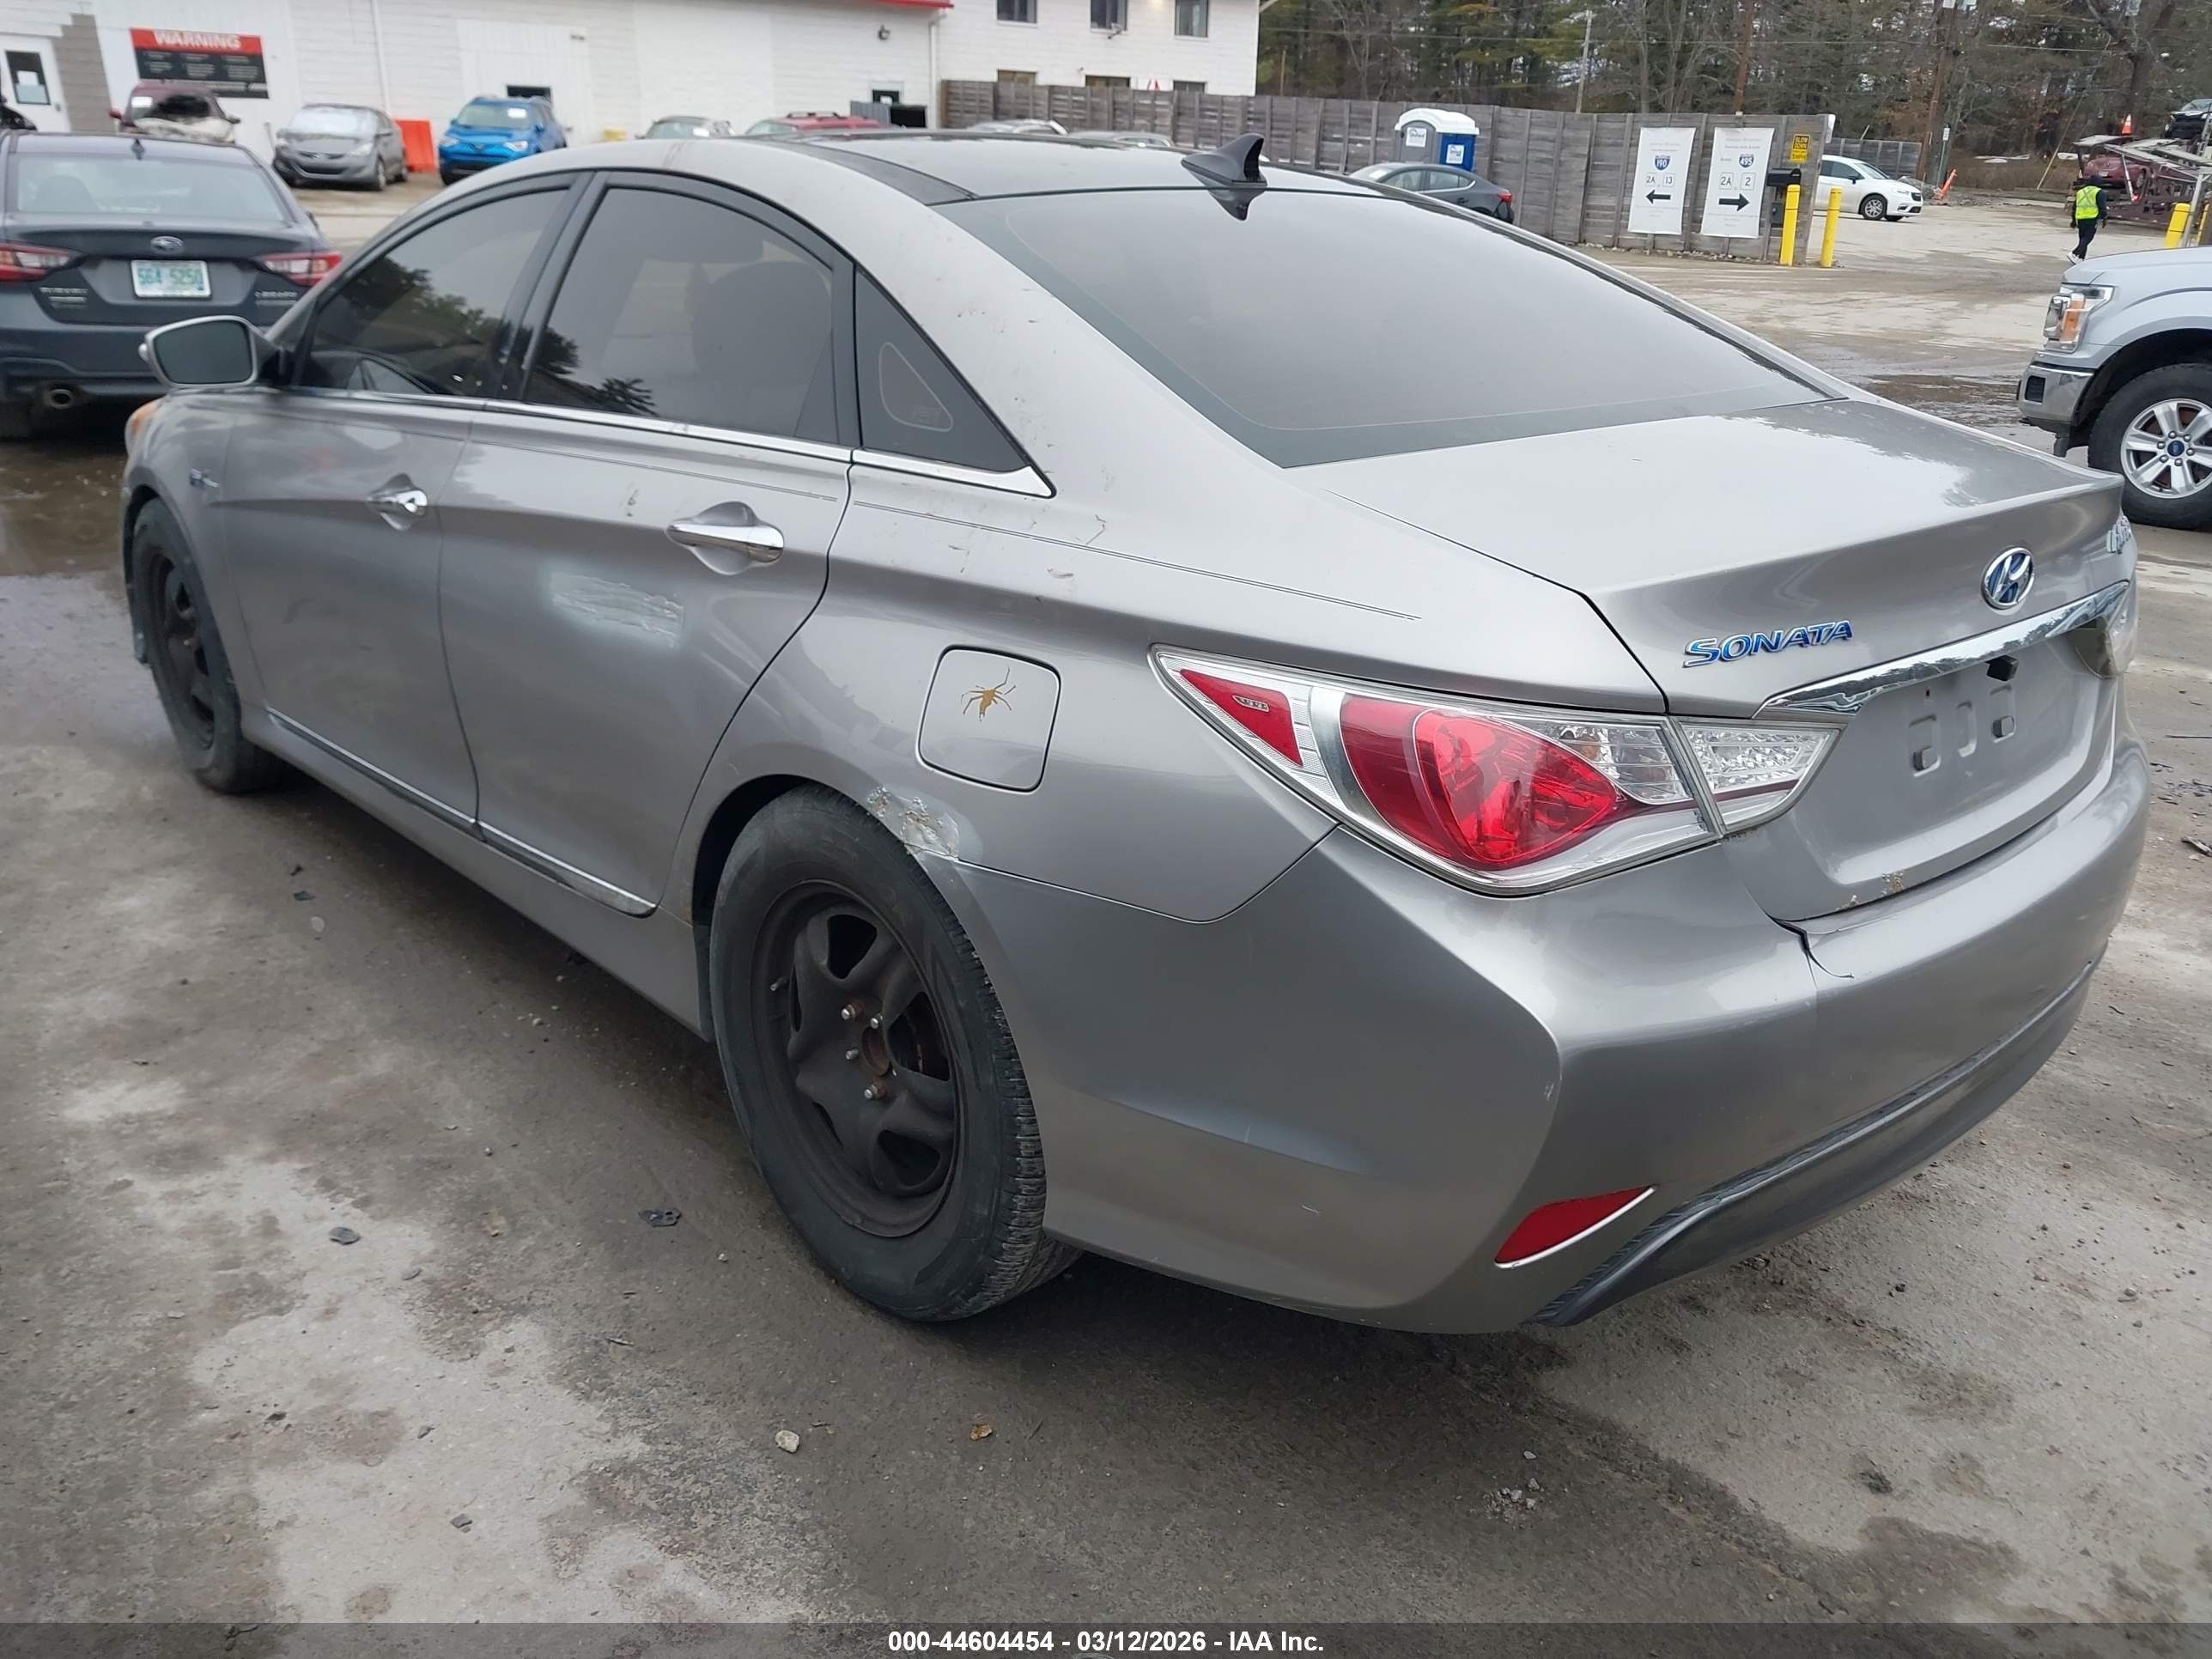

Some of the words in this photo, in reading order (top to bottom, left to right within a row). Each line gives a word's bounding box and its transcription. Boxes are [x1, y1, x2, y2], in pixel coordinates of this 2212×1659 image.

[152, 29, 241, 48] WARNING
[1740, 157, 1753, 166] 495
[1646, 175, 1656, 184] 2A
[1720, 177, 1732, 186] 2A
[1745, 177, 1751, 186] 2
[1682, 620, 1854, 668] SONATA
